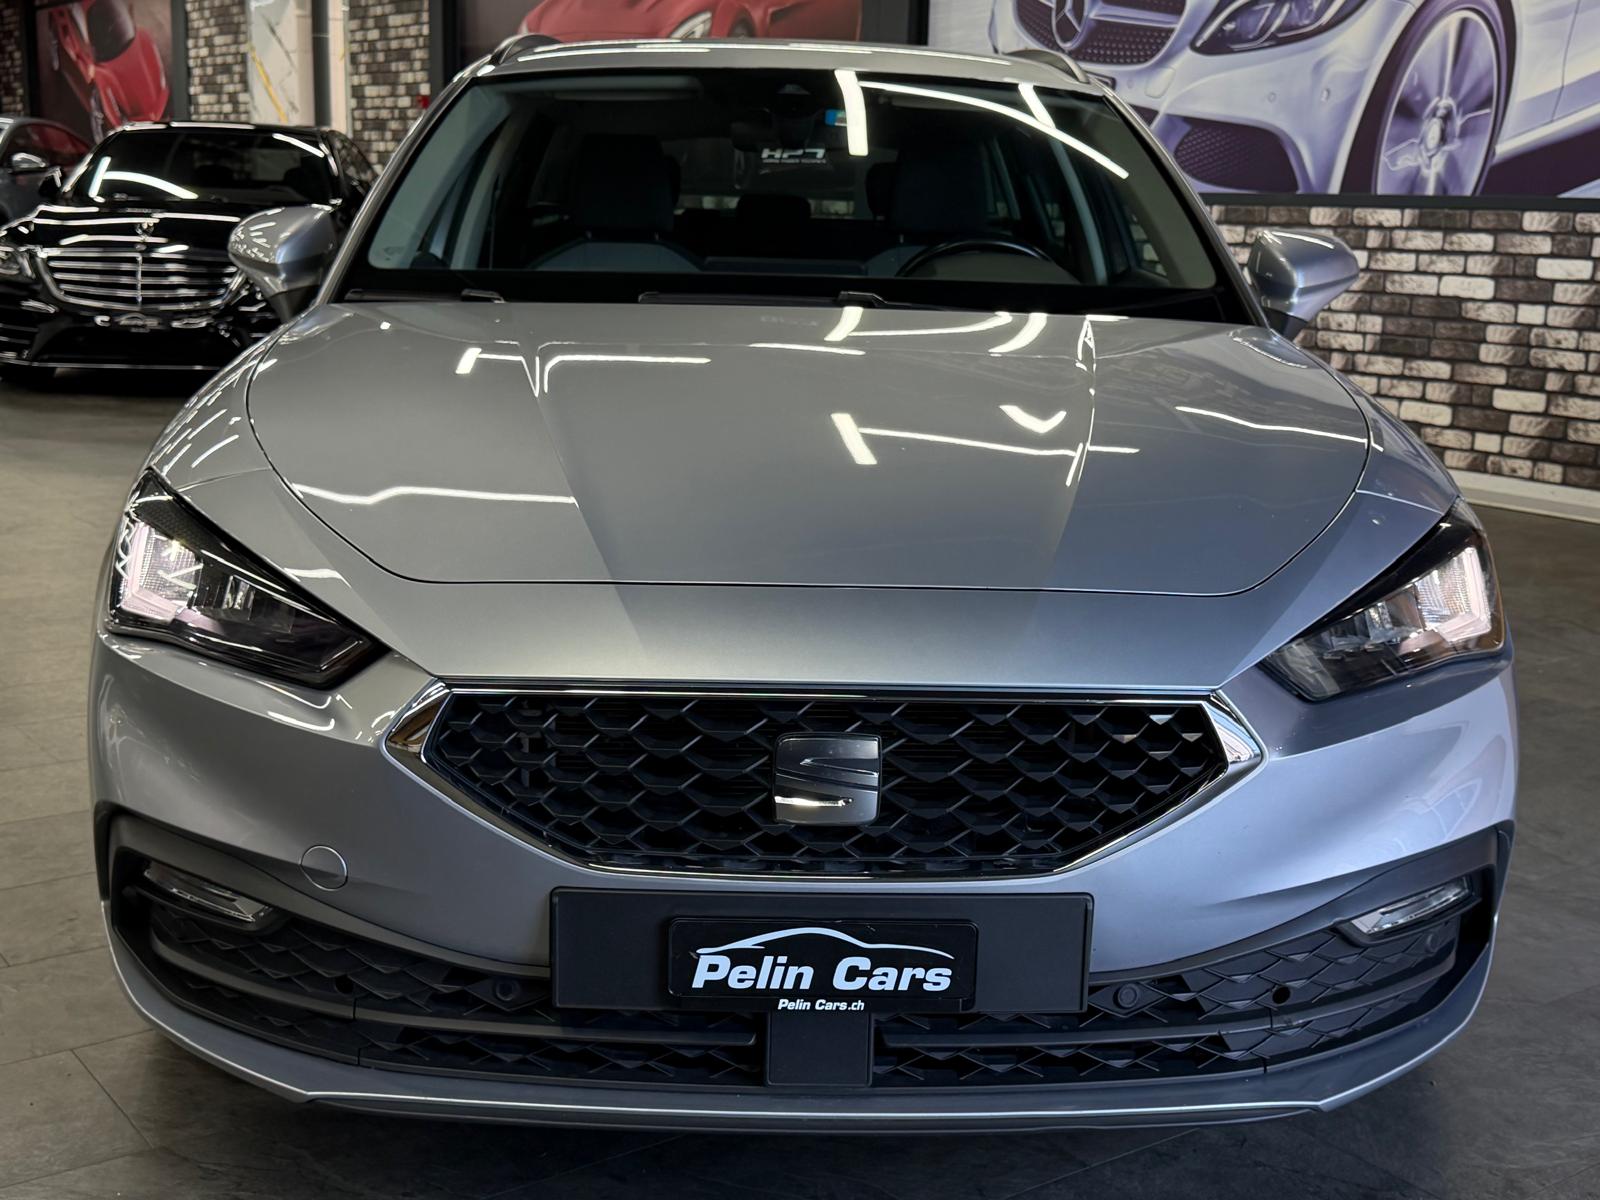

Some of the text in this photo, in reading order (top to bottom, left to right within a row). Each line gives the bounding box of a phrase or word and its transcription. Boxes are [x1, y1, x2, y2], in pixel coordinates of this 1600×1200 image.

[691, 954, 953, 992] Pelin Cars
[777, 998, 865, 1011] Pelin Cars.ch
